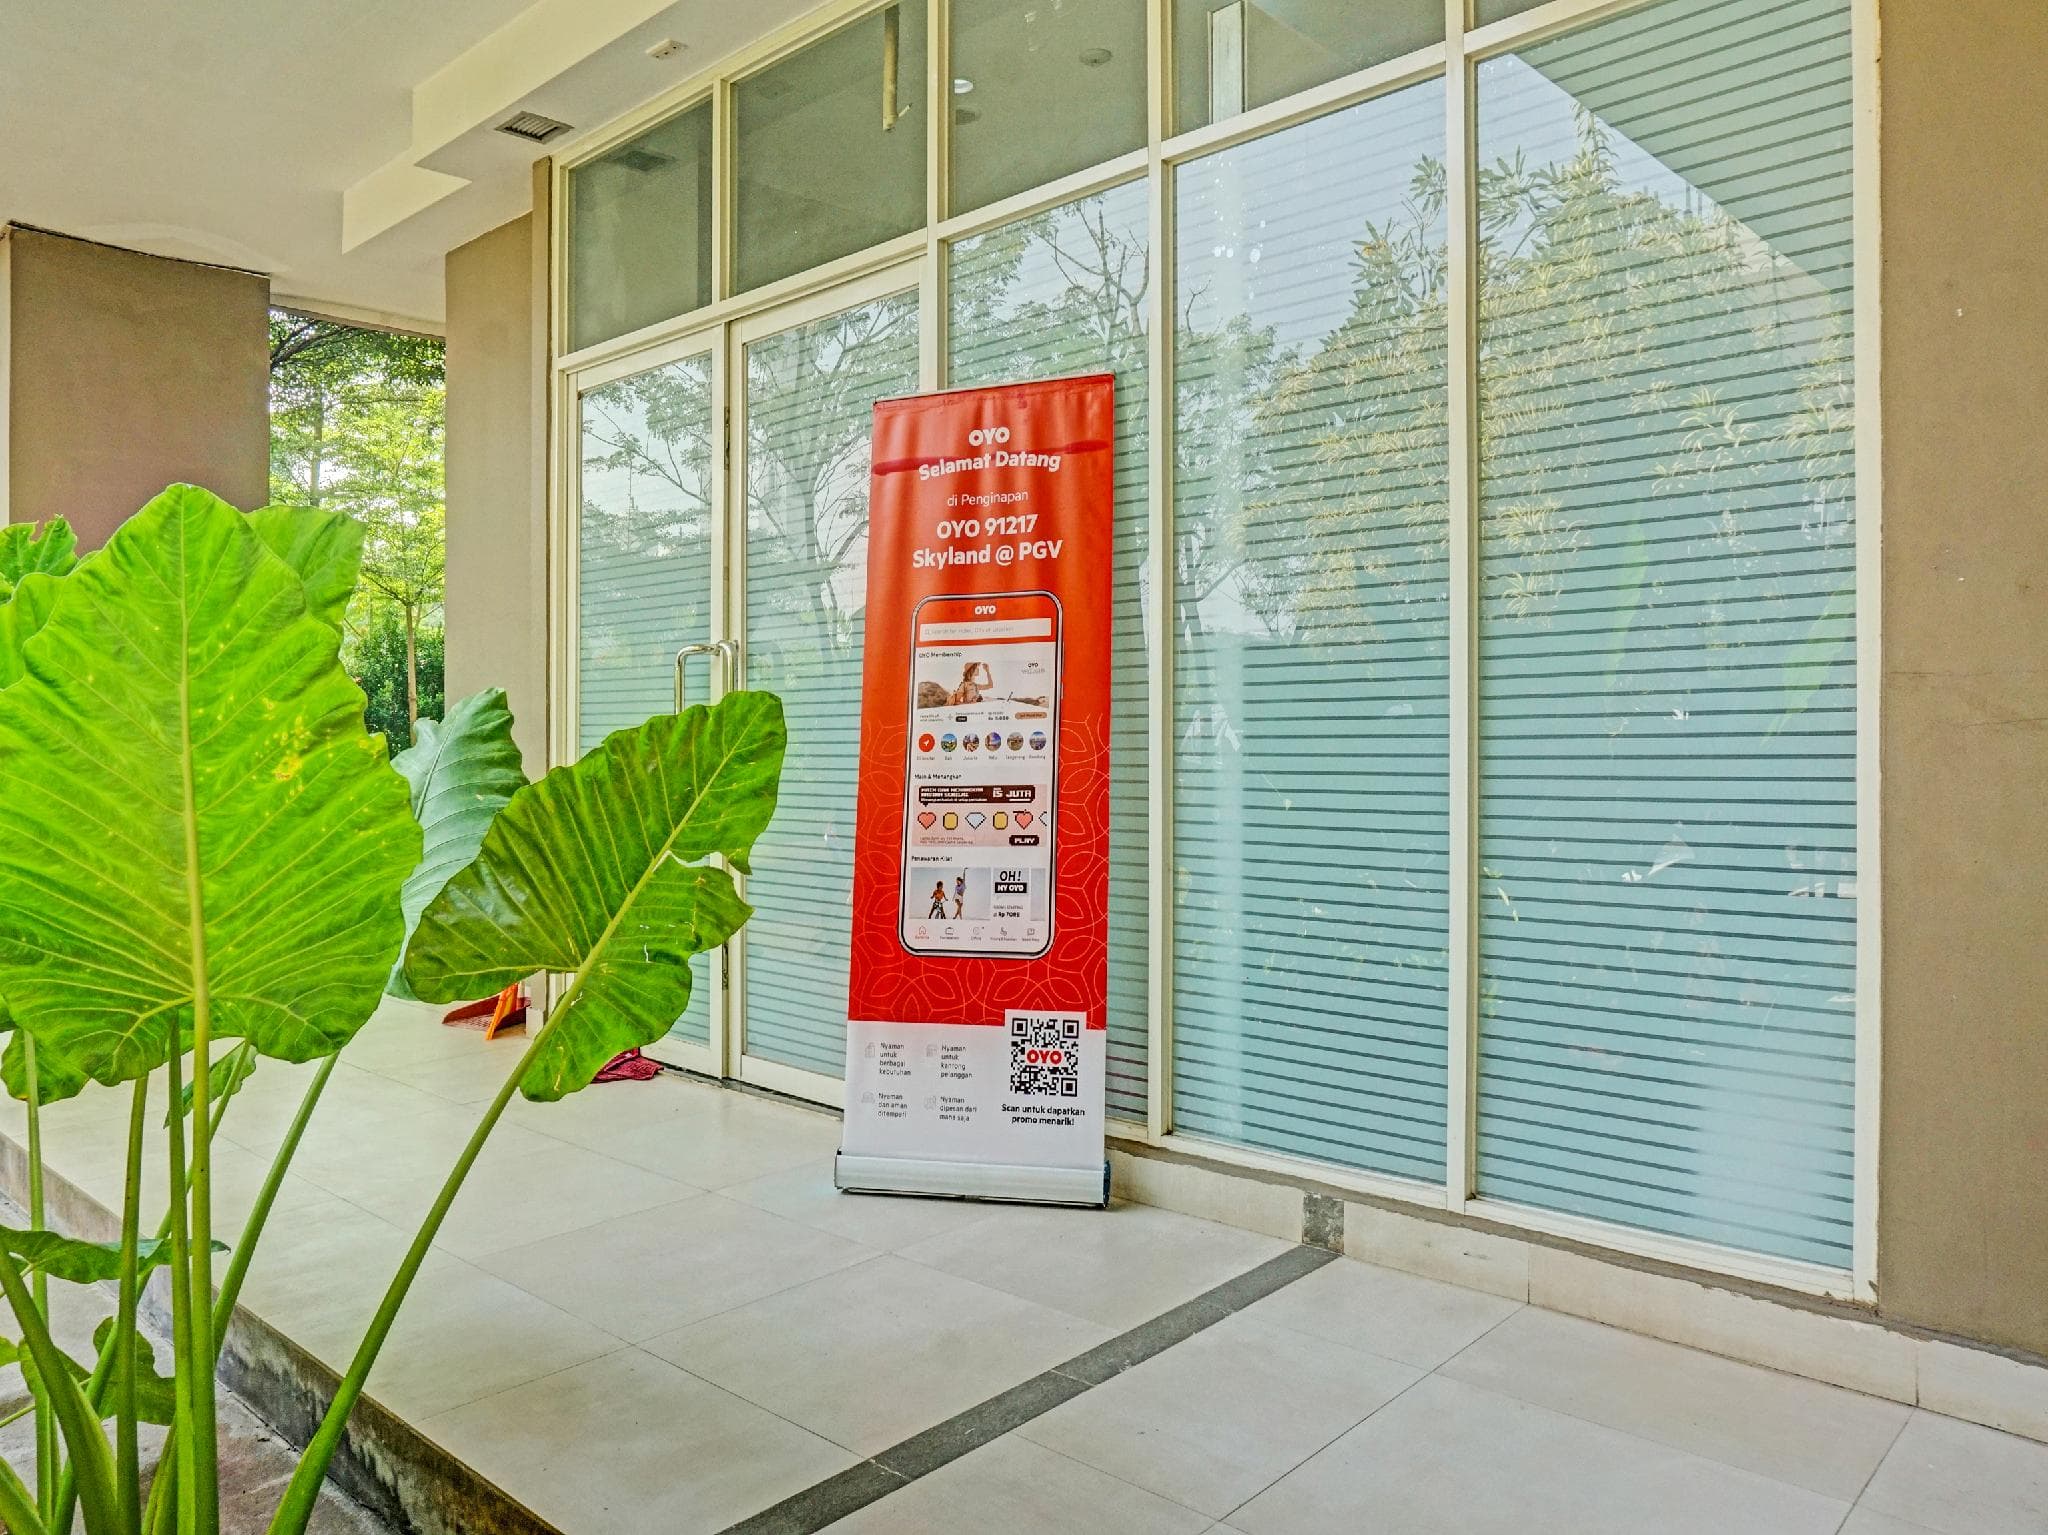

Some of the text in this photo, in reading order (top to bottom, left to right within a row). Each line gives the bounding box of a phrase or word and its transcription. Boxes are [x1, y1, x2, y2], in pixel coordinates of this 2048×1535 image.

[968, 426, 1011, 447] OYO
[918, 450, 1061, 481] Selamat Datang
[947, 490, 1029, 507] di Penginapan
[936, 514, 1038, 540] OYO 91217
[912, 540, 1063, 570] Skyland @ PGV
[974, 605, 997, 615] OYO
[1005, 789, 1032, 798] JUTA
[999, 870, 1022, 882] OH!
[1008, 884, 1024, 892] OYO
[880, 1042, 904, 1050] Nyaman
[941, 1045, 966, 1053] Nyaman
[1026, 1049, 1062, 1065] OYO
[879, 1060, 906, 1068] berbagai
[878, 1092, 903, 1101] Nyaman
[940, 1096, 965, 1104] Nyaman
[964, 1105, 977, 1113] dari
[1001, 1103, 1086, 1116] Scan untuk dapatkan
[1011, 1116, 1075, 1126] promo menarik!
